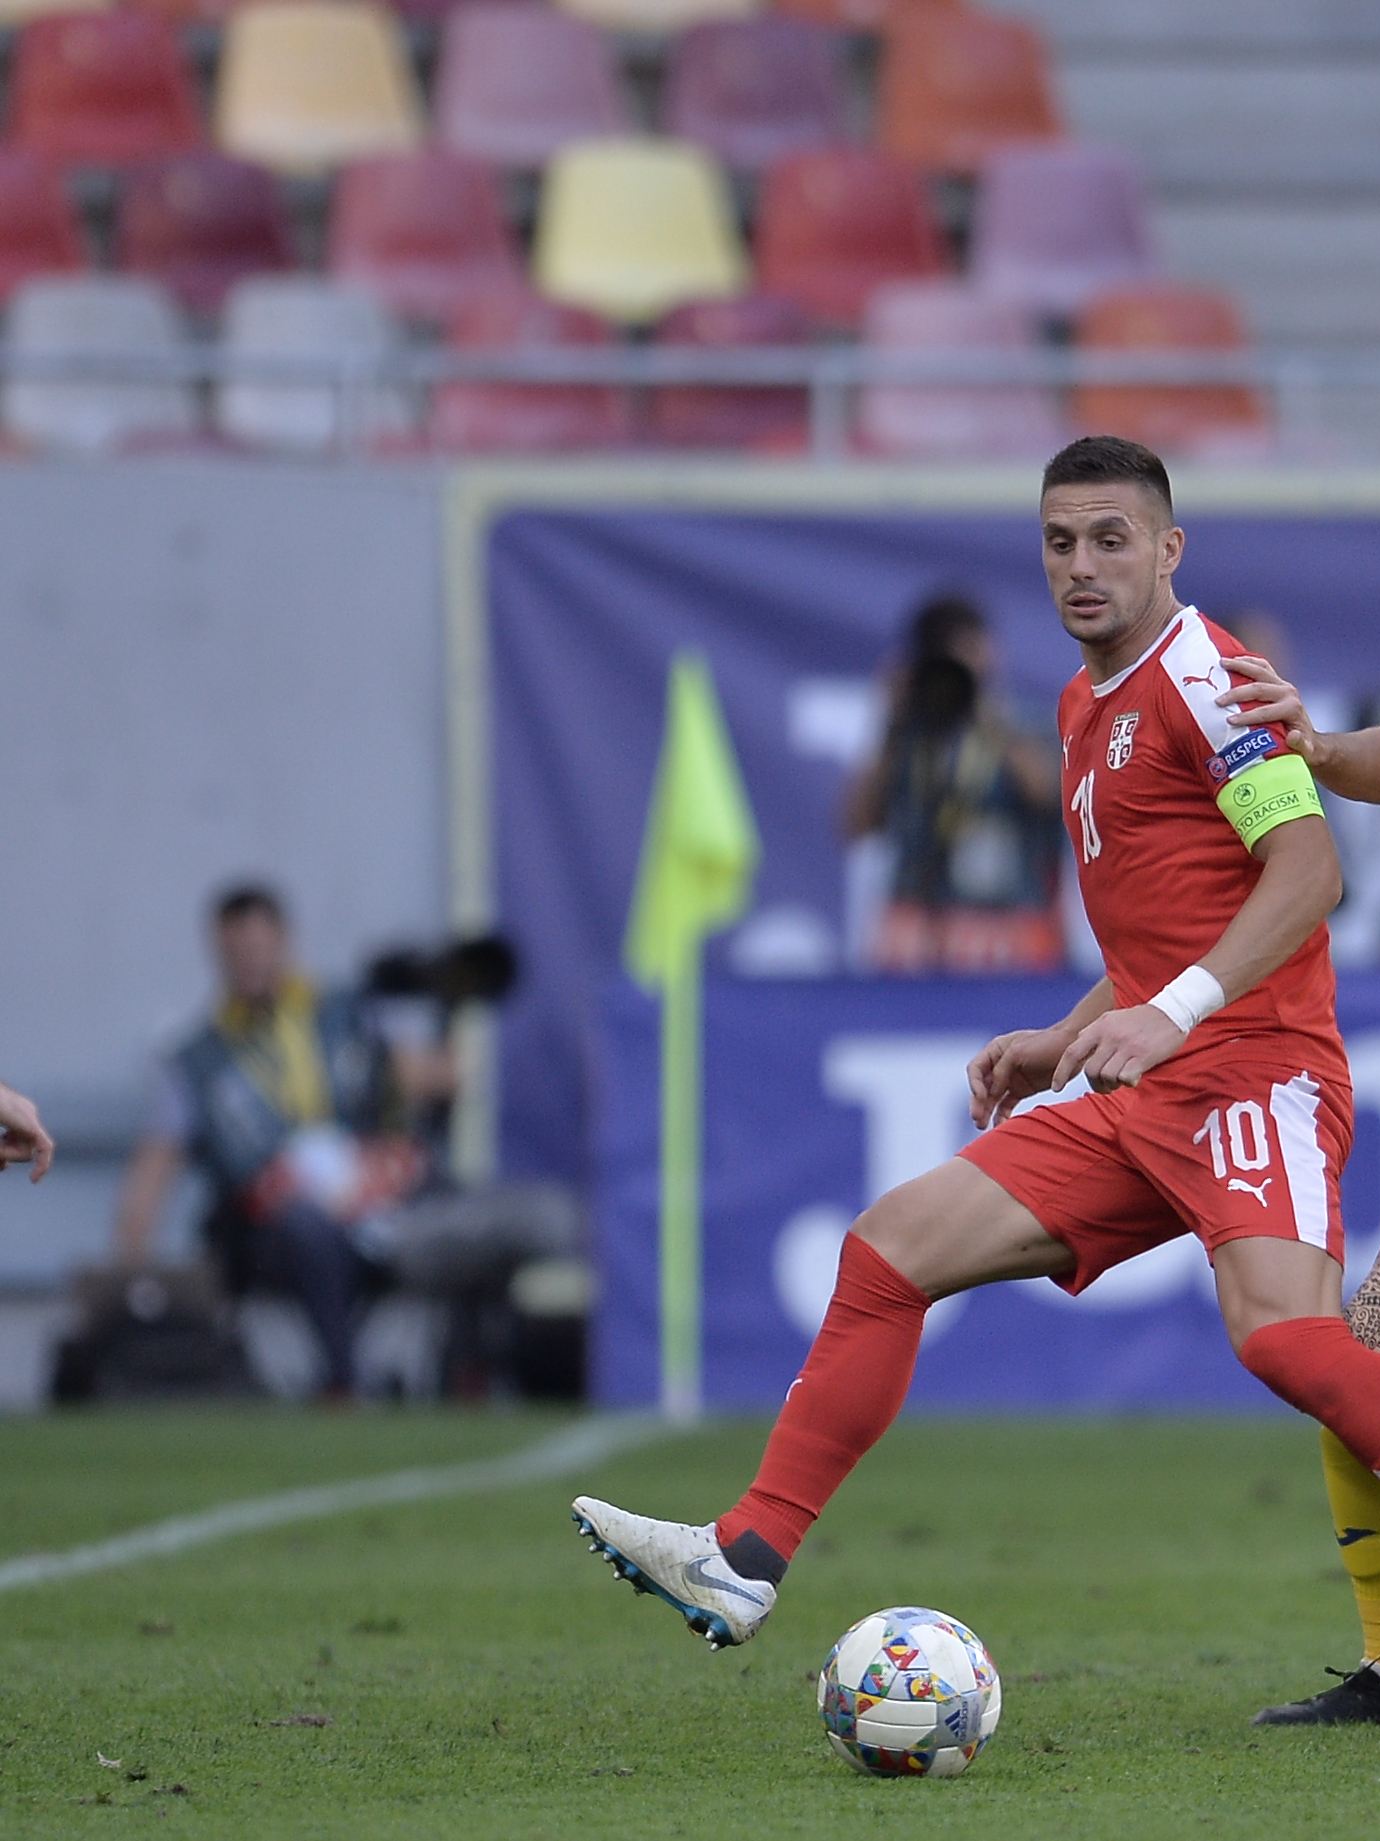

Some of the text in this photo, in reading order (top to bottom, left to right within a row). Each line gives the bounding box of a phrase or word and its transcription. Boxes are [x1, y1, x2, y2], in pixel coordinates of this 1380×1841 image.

[1225, 734, 1272, 766] RESPECT
[1071, 769, 1101, 864] 10
[1253, 794, 1299, 820] RACISM
[1193, 1100, 1269, 1178] 10
